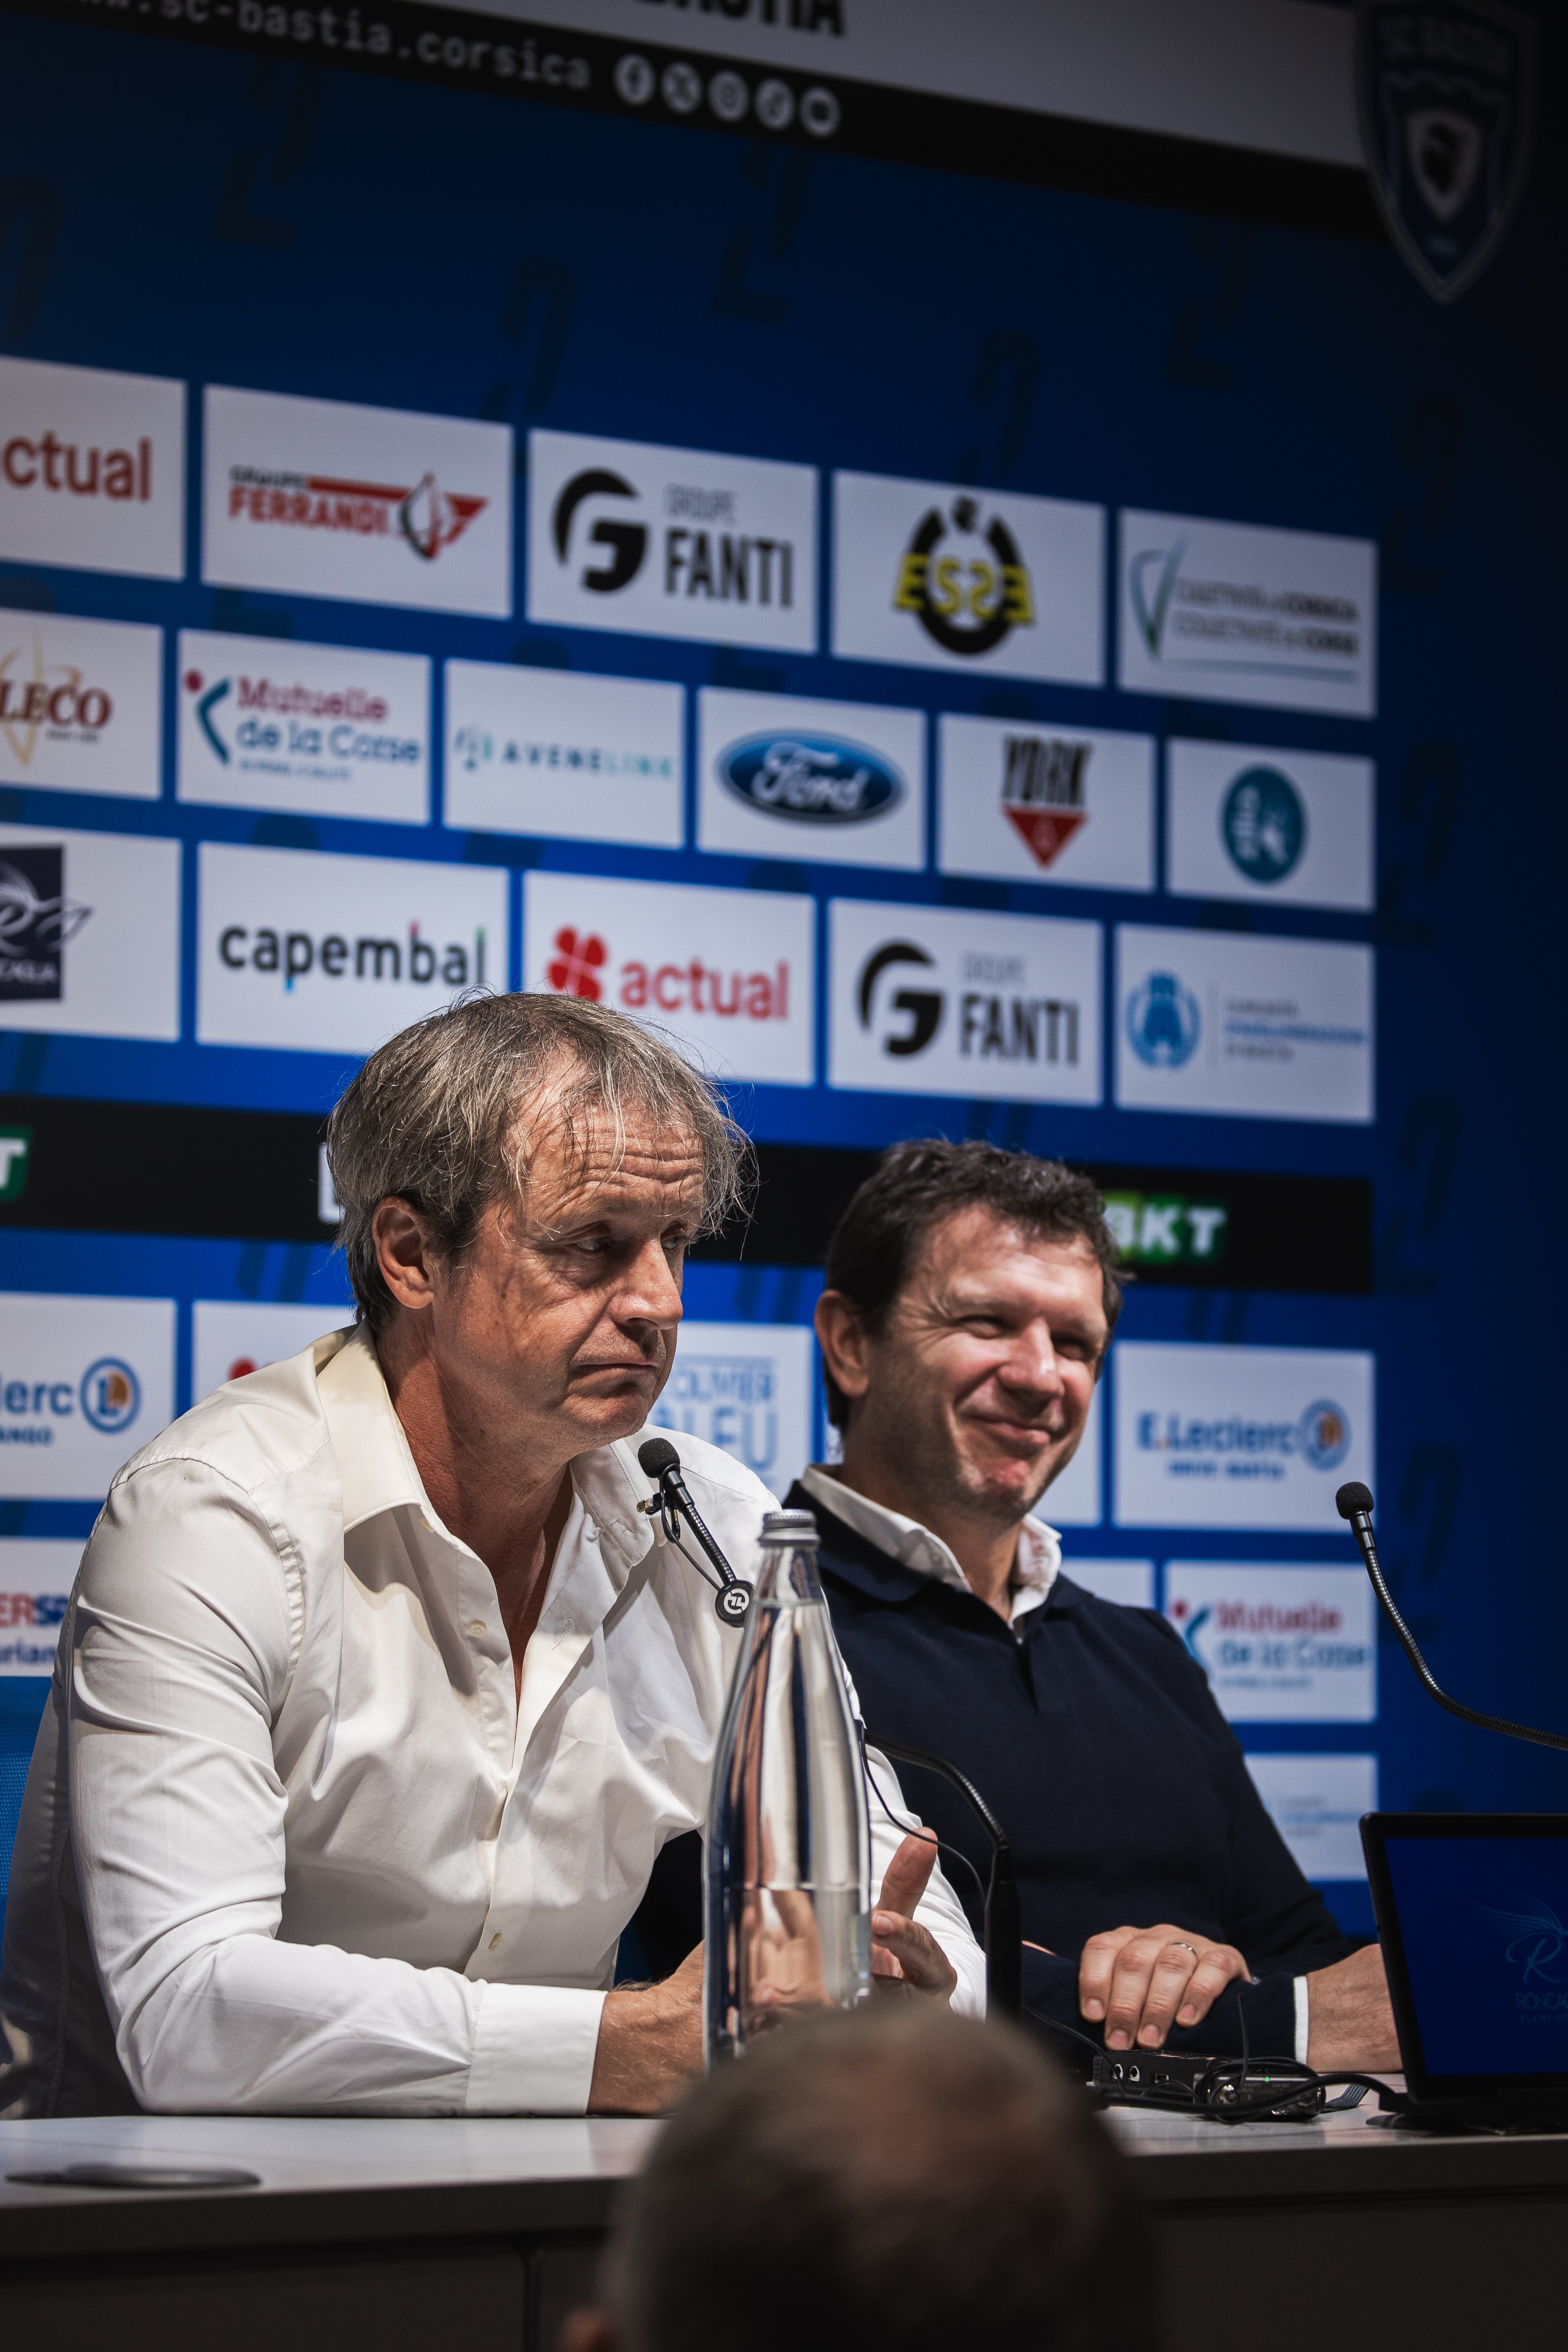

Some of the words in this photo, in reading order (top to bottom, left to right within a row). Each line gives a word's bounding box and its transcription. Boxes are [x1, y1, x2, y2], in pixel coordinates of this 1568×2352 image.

[665, 526, 793, 608] FANTI
[236, 716, 281, 751] de
[238, 676, 389, 725] Mutuelle
[751, 741, 870, 812] Ford
[220, 920, 486, 992] capembal
[620, 958, 789, 1020] actual
[959, 994, 1079, 1068] FANTI
